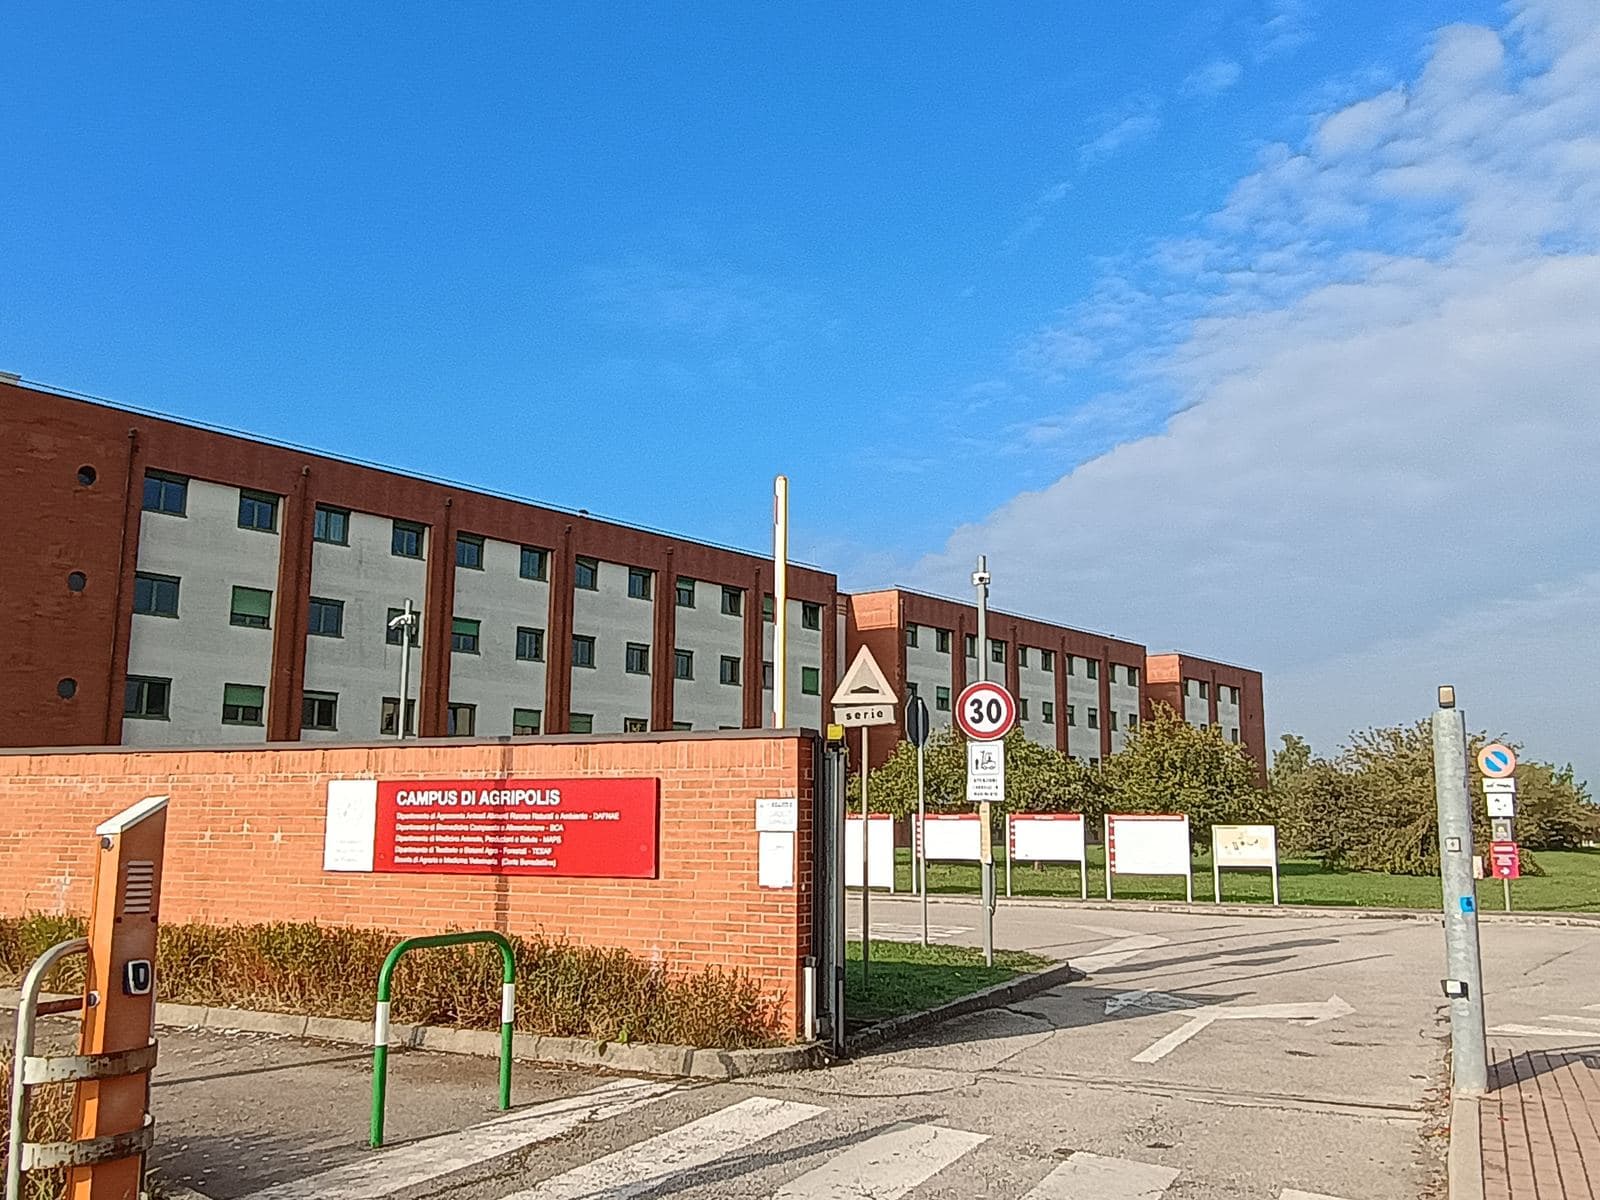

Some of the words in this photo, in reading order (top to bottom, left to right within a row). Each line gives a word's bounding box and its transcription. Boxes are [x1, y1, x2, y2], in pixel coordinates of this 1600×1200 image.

[845, 709, 884, 720] serie
[970, 698, 1002, 724] 30
[396, 791, 458, 806] CAMPUS
[461, 791, 476, 805] DI
[479, 790, 560, 805] AGRIPOLIS
